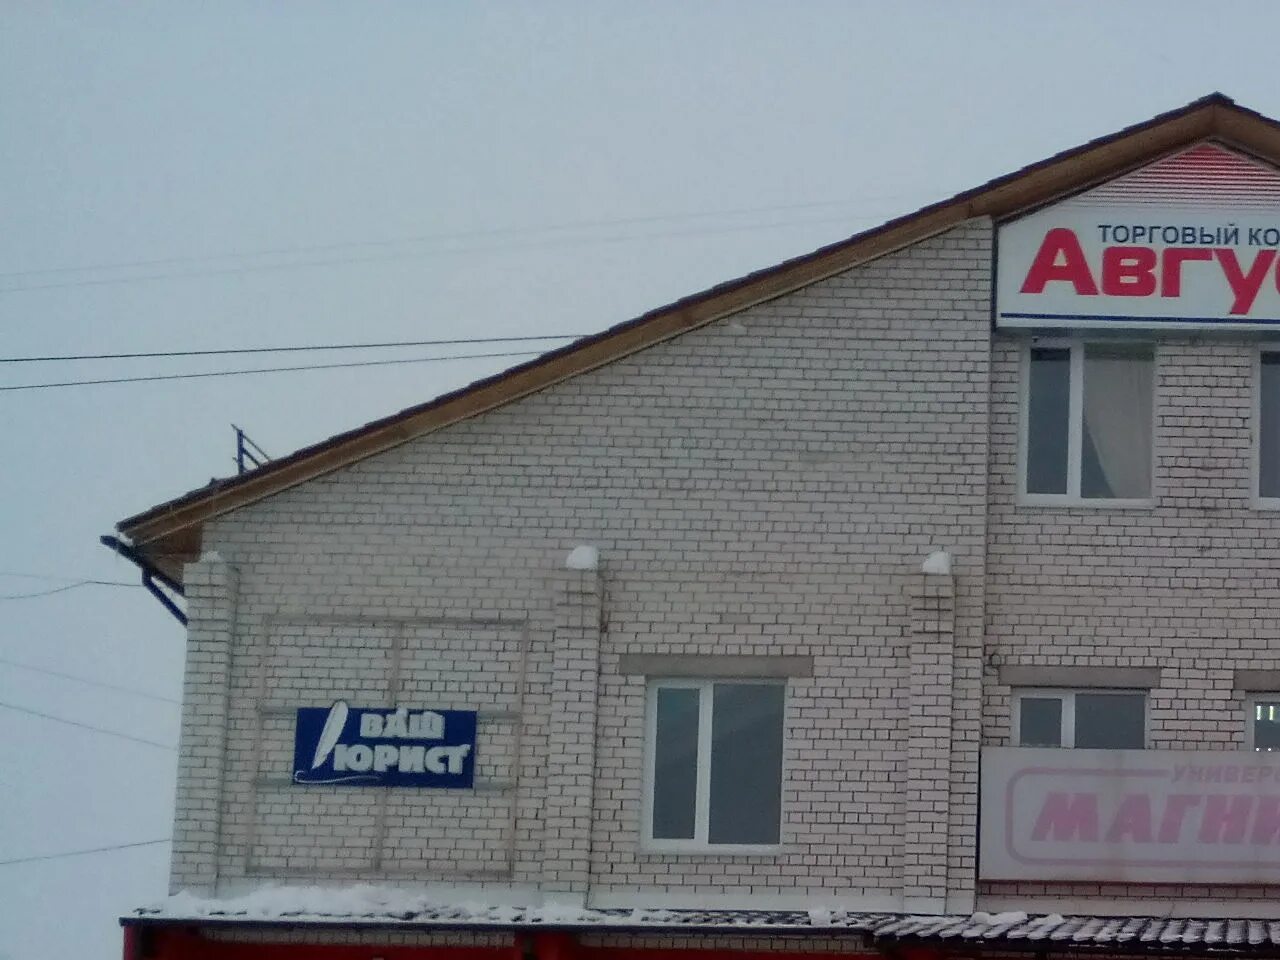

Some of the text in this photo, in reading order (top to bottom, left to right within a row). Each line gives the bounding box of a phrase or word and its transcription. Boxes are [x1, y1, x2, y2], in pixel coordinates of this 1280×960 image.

[1098, 223, 1239, 246] ТОРГОВЫЙ
[360, 711, 446, 740] ВАШ
[333, 743, 471, 775] ЮРИСТ
